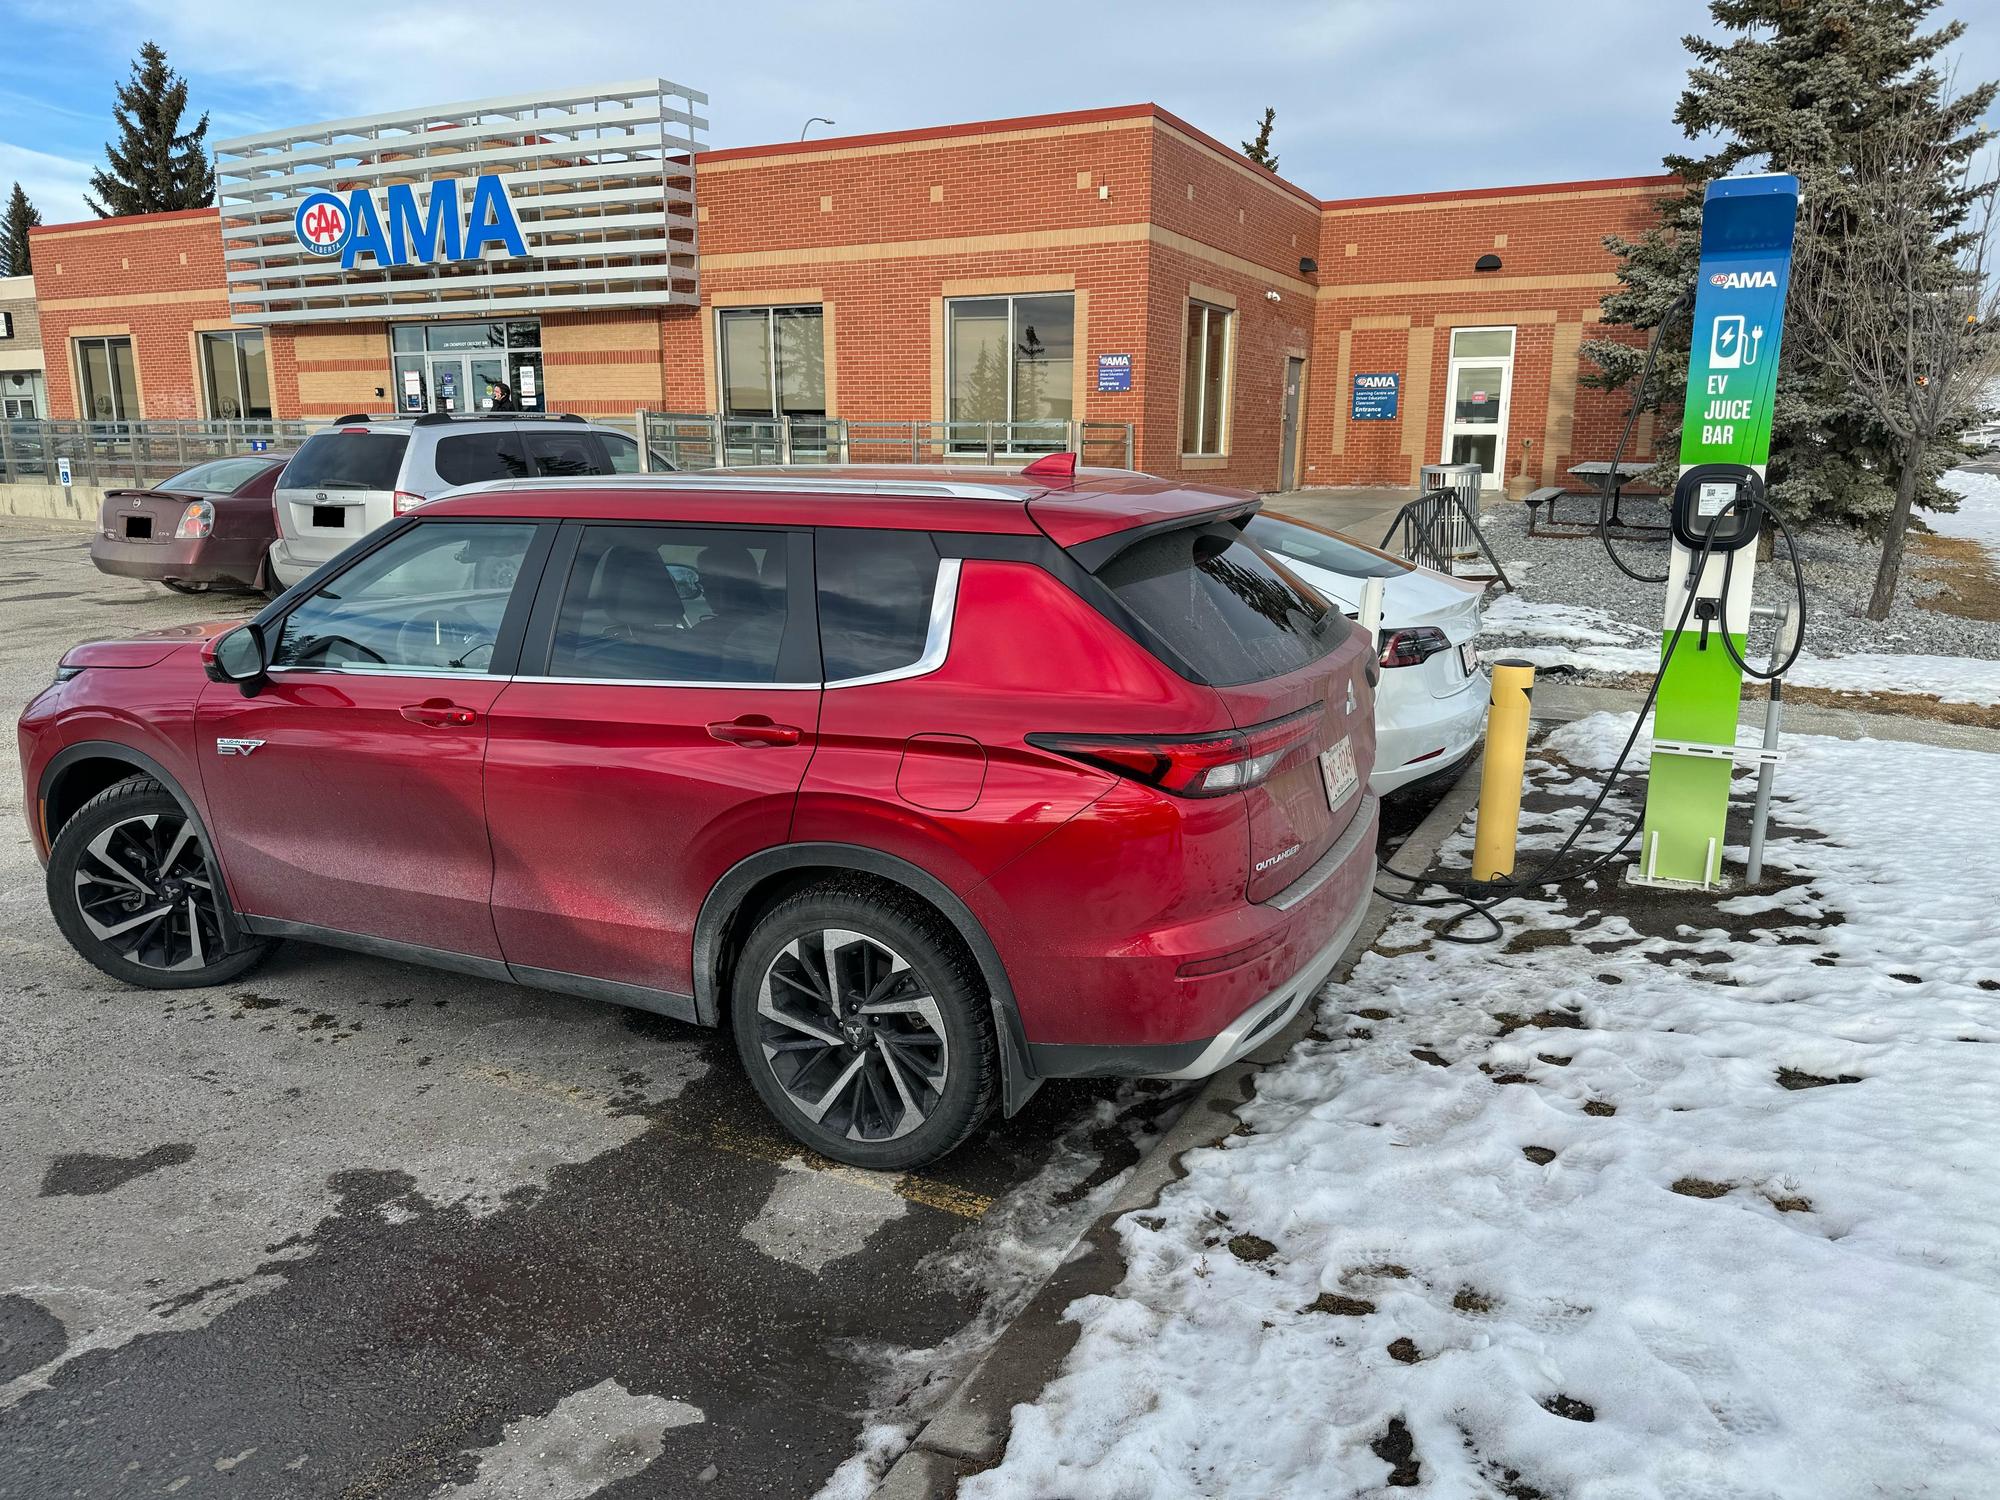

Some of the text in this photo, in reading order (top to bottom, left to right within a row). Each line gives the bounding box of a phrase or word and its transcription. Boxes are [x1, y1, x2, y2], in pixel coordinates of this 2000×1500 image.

[305, 174, 529, 269] CAA AMA
[310, 242, 341, 254] ALBERTA
[1723, 271, 1777, 289] AMA
[1106, 356, 1129, 366] AMA
[1364, 377, 1395, 387] AMA
[1707, 375, 1728, 394] EV
[1704, 400, 1752, 420] JUICE
[1702, 425, 1734, 445] BAR
[1255, 843, 1300, 871] OUTLANDER
